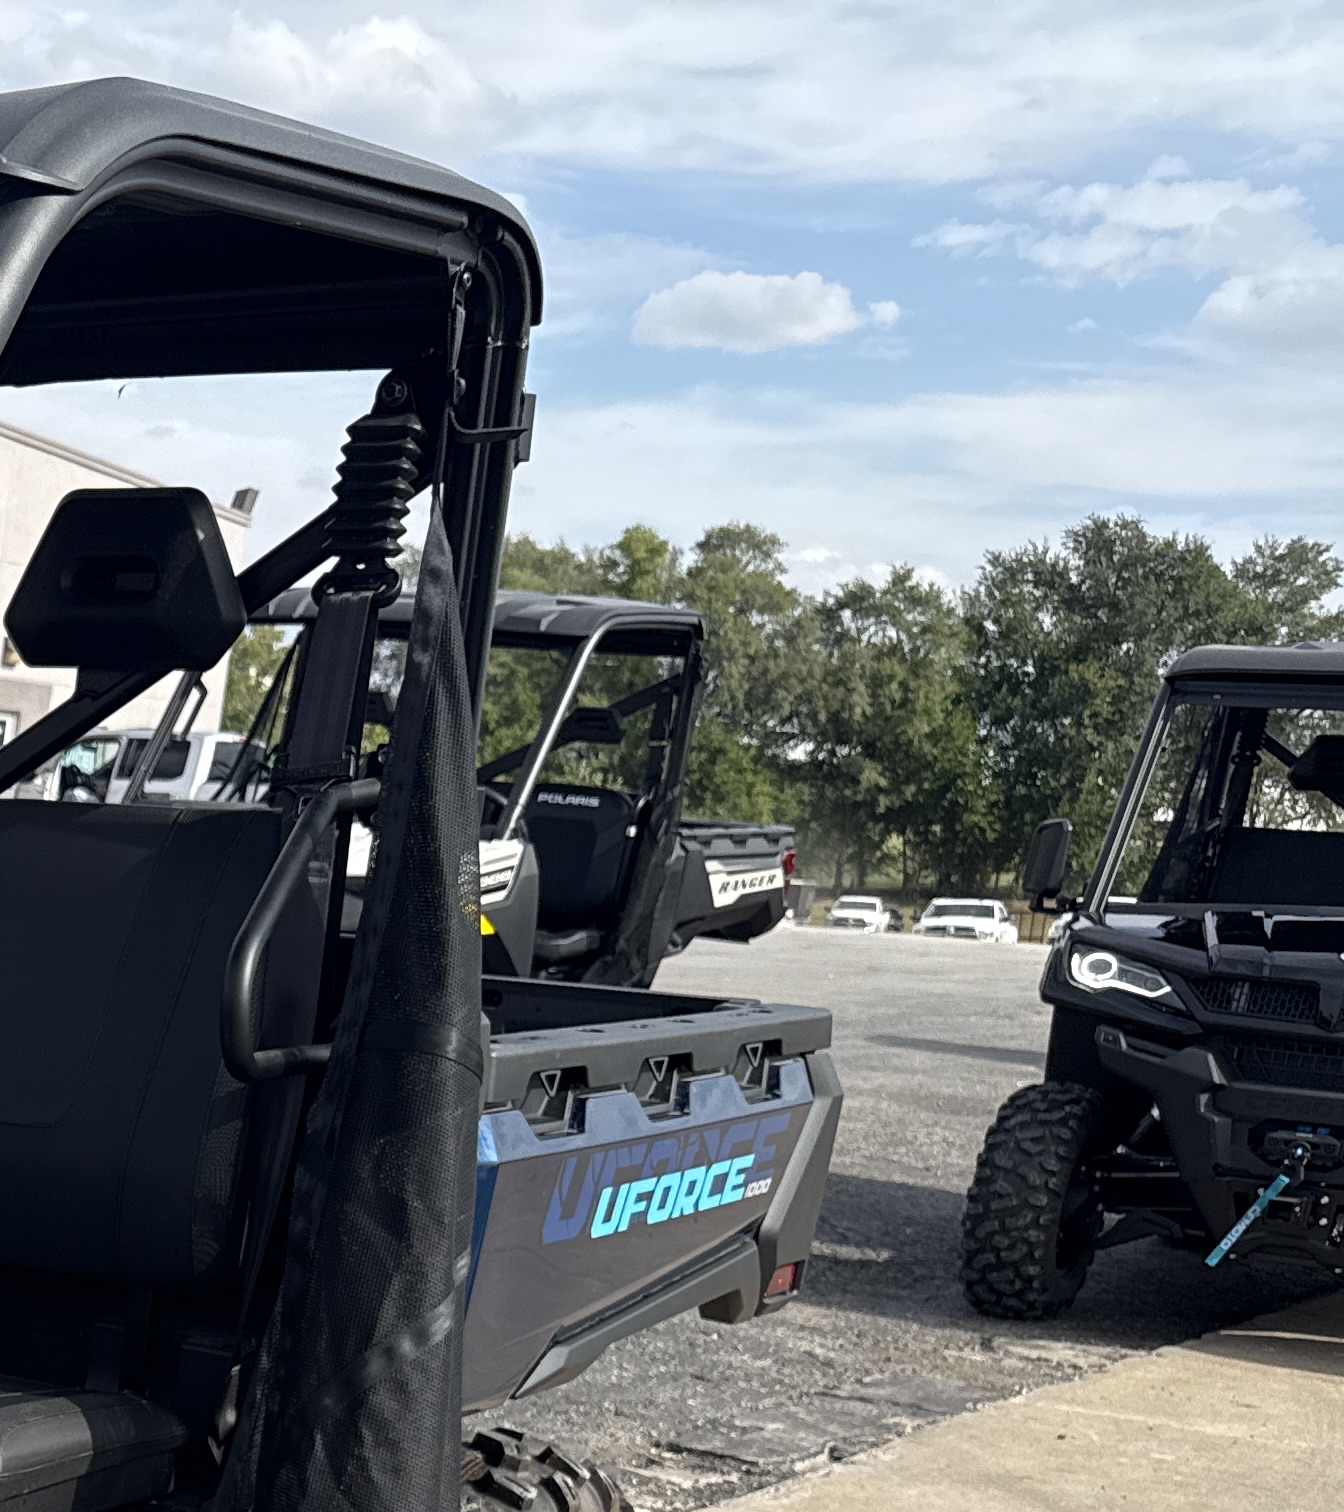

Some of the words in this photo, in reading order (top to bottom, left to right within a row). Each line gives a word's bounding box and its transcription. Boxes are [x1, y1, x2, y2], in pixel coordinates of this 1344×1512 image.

[537, 791, 601, 808] POLARIS
[718, 874, 778, 895] RANGER
[590, 1153, 756, 1239] UFORCE
[744, 1178, 773, 1199] 1000
[1219, 1205, 1261, 1251] CFMOTO
